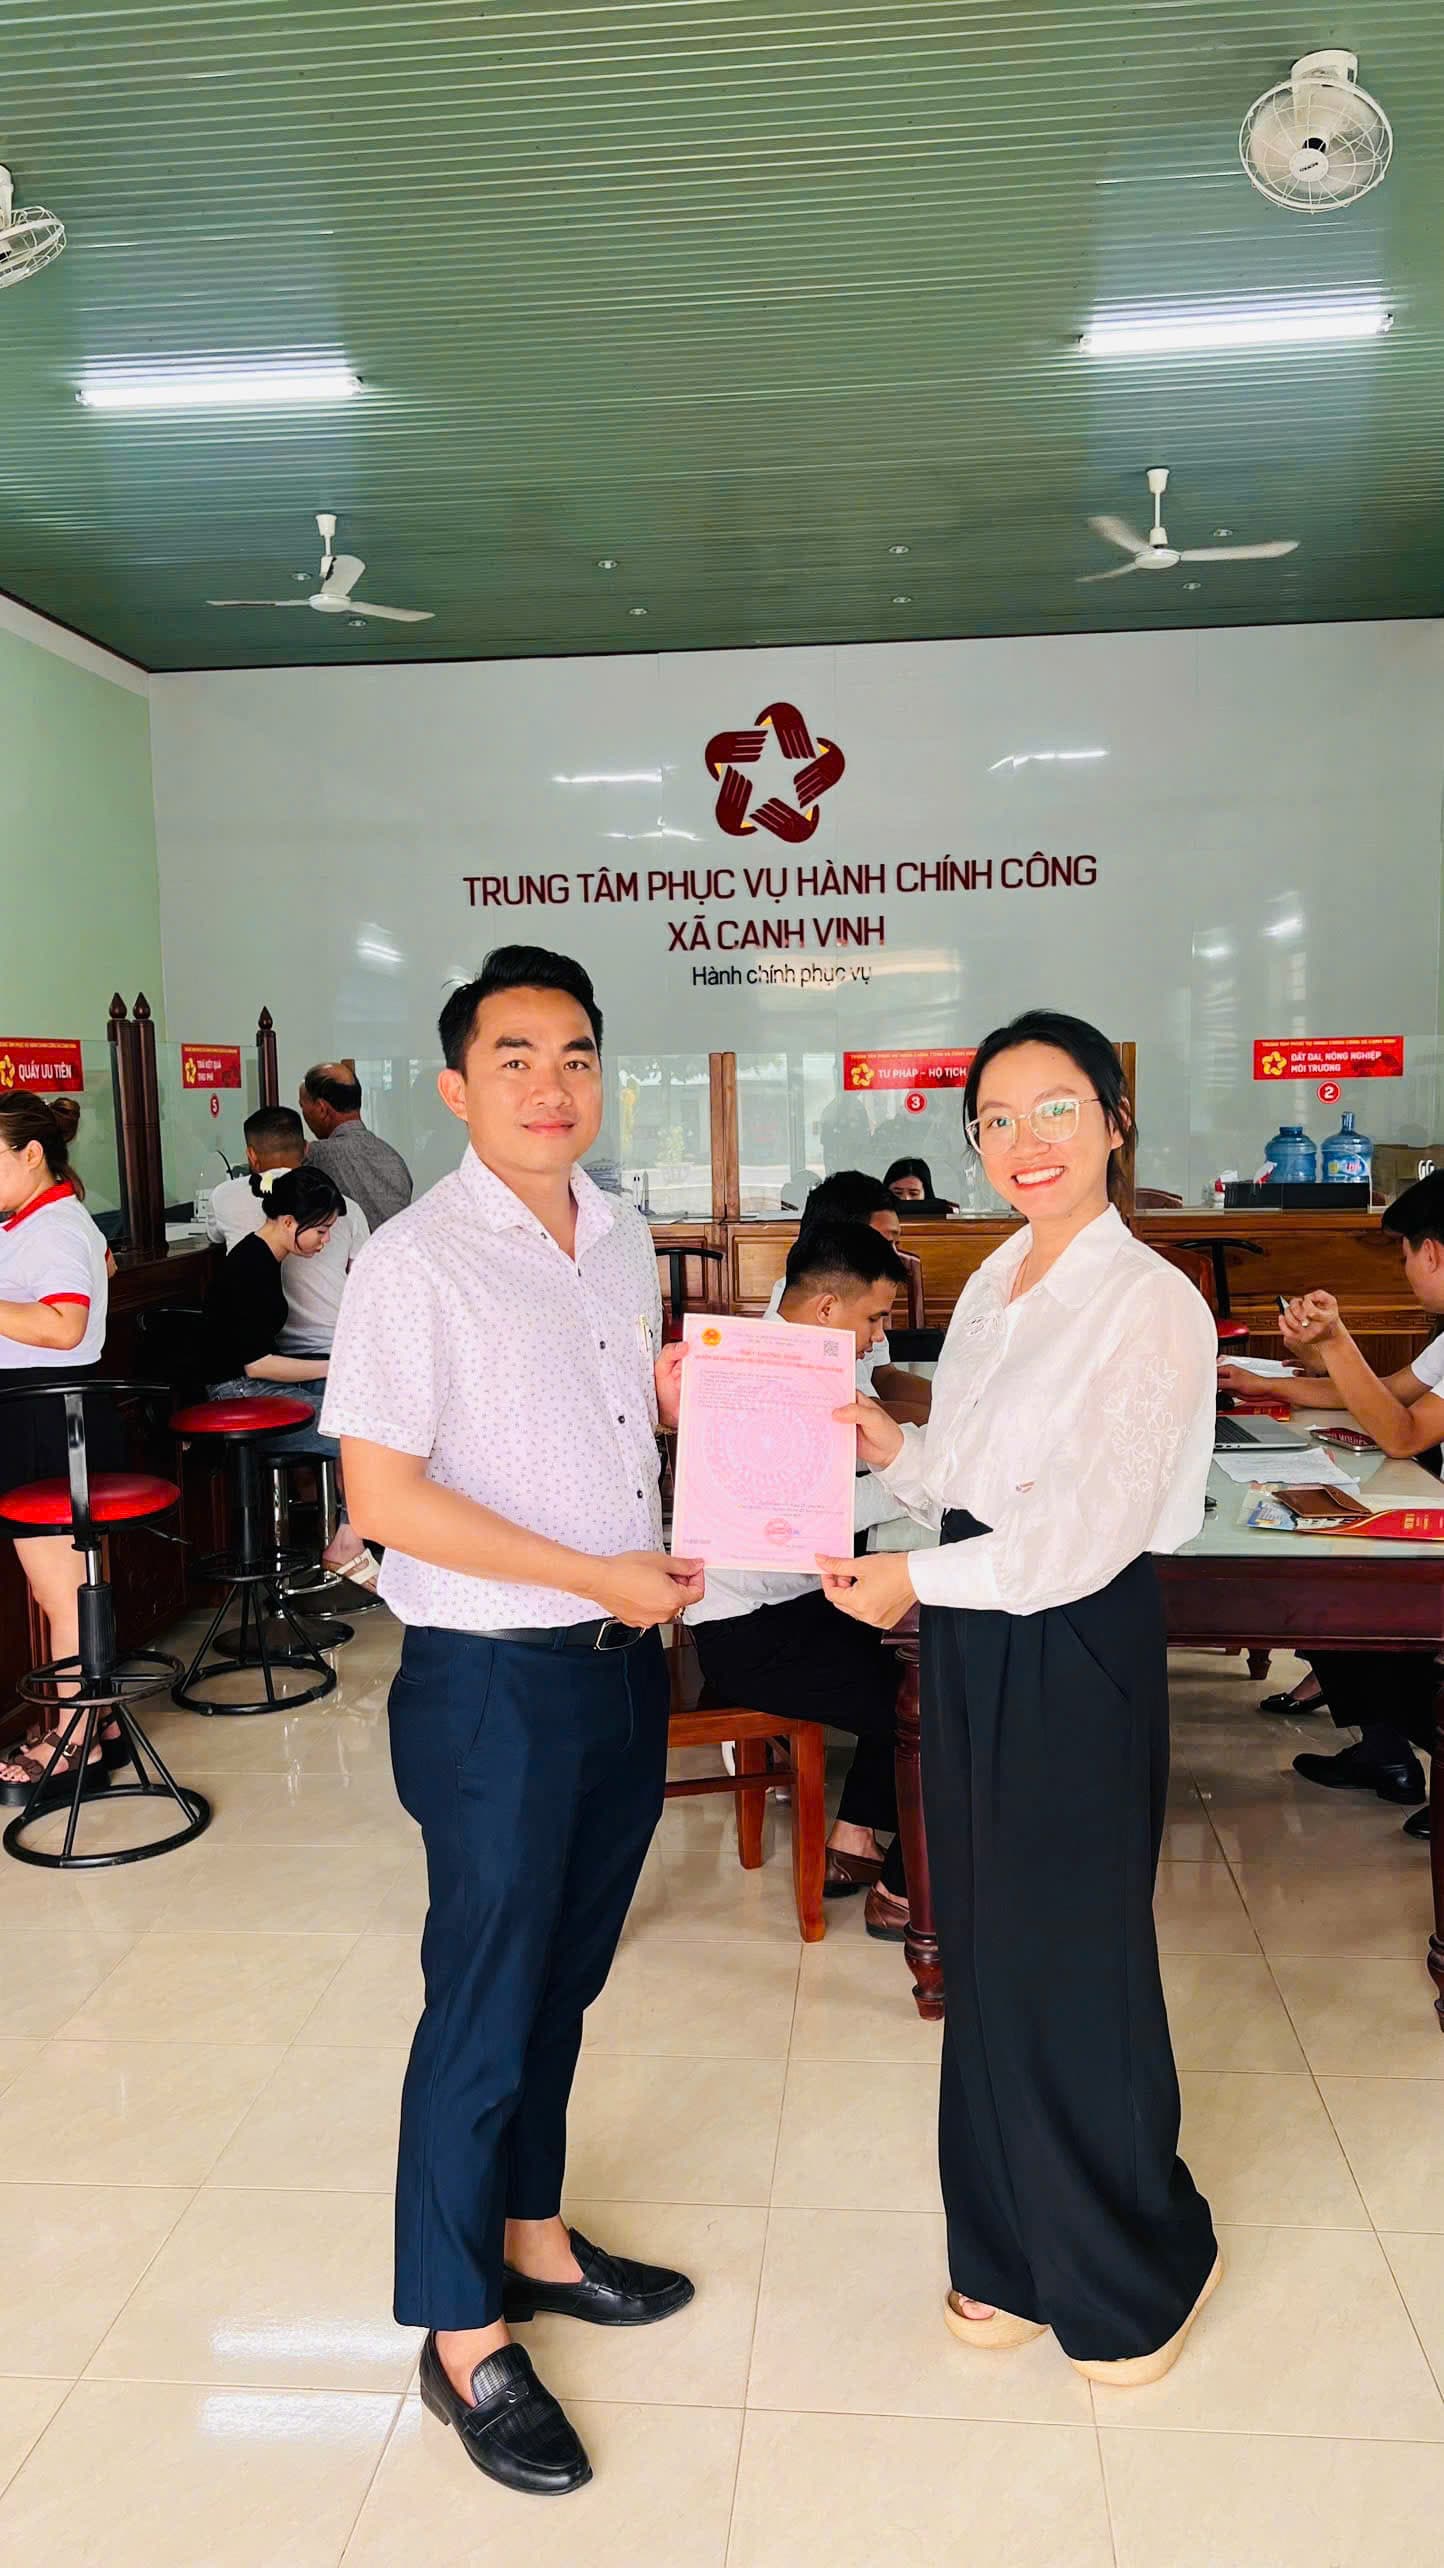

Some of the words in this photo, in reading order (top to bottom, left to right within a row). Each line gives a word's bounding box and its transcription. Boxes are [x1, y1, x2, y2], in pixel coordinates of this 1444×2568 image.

[463, 873, 569, 906] TRUNG
[576, 866, 638, 903] TÂM
[648, 869, 735, 905] PHỤC
[743, 868, 788, 904] VỤ
[797, 859, 886, 897] HÀNH
[896, 854, 993, 893] CHÍNH
[1000, 851, 1098, 889] CÔNG
[667, 914, 711, 951] XÃ
[717, 919, 805, 950] CANH
[812, 915, 885, 948] VINH
[692, 965, 742, 986] Hành
[746, 963, 796, 985] chính
[800, 963, 846, 988] phục
[850, 966, 872, 985] vụ
[54, 1060, 72, 1080] TIÊN
[893, 1067, 919, 1079] PHÁP
[945, 1067, 967, 1078] TỊCH
[1323, 1086, 1334, 1099] 2
[211, 1098, 218, 1113] 5
[911, 1096, 921, 1109] 3
